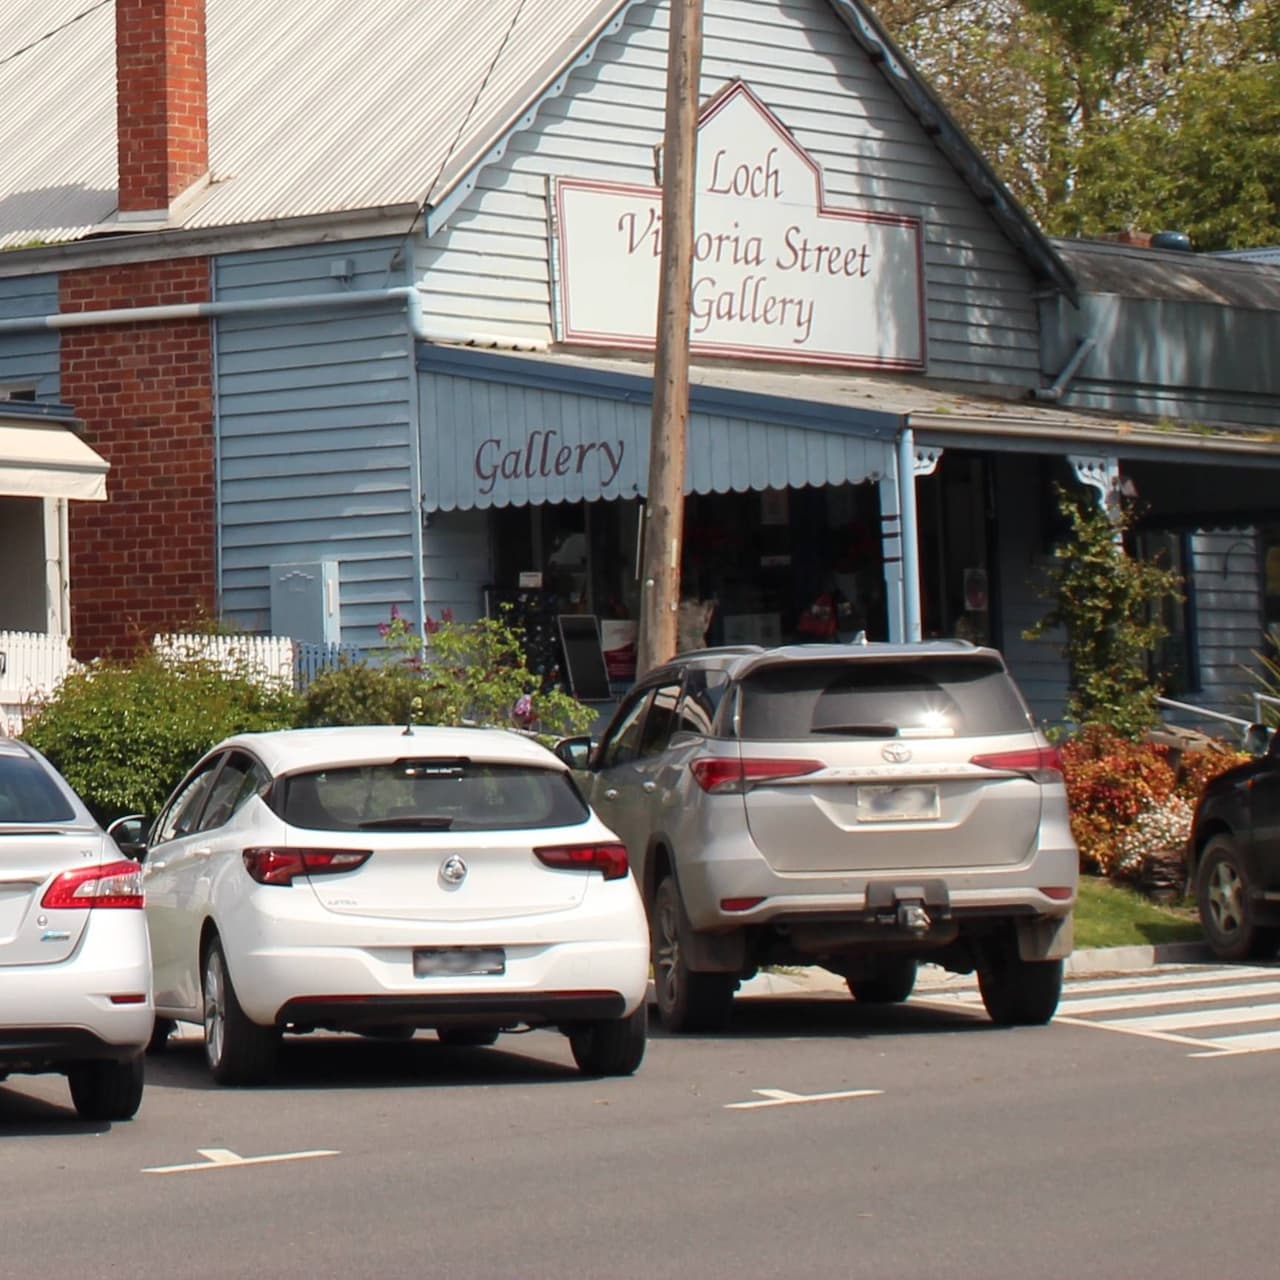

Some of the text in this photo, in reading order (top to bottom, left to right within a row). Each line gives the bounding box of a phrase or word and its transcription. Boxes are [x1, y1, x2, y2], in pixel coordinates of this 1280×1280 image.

[707, 147, 783, 199] Loch
[618, 208, 872, 278] Vioria Street
[690, 275, 815, 344] Gallery
[475, 430, 625, 495] Gallery
